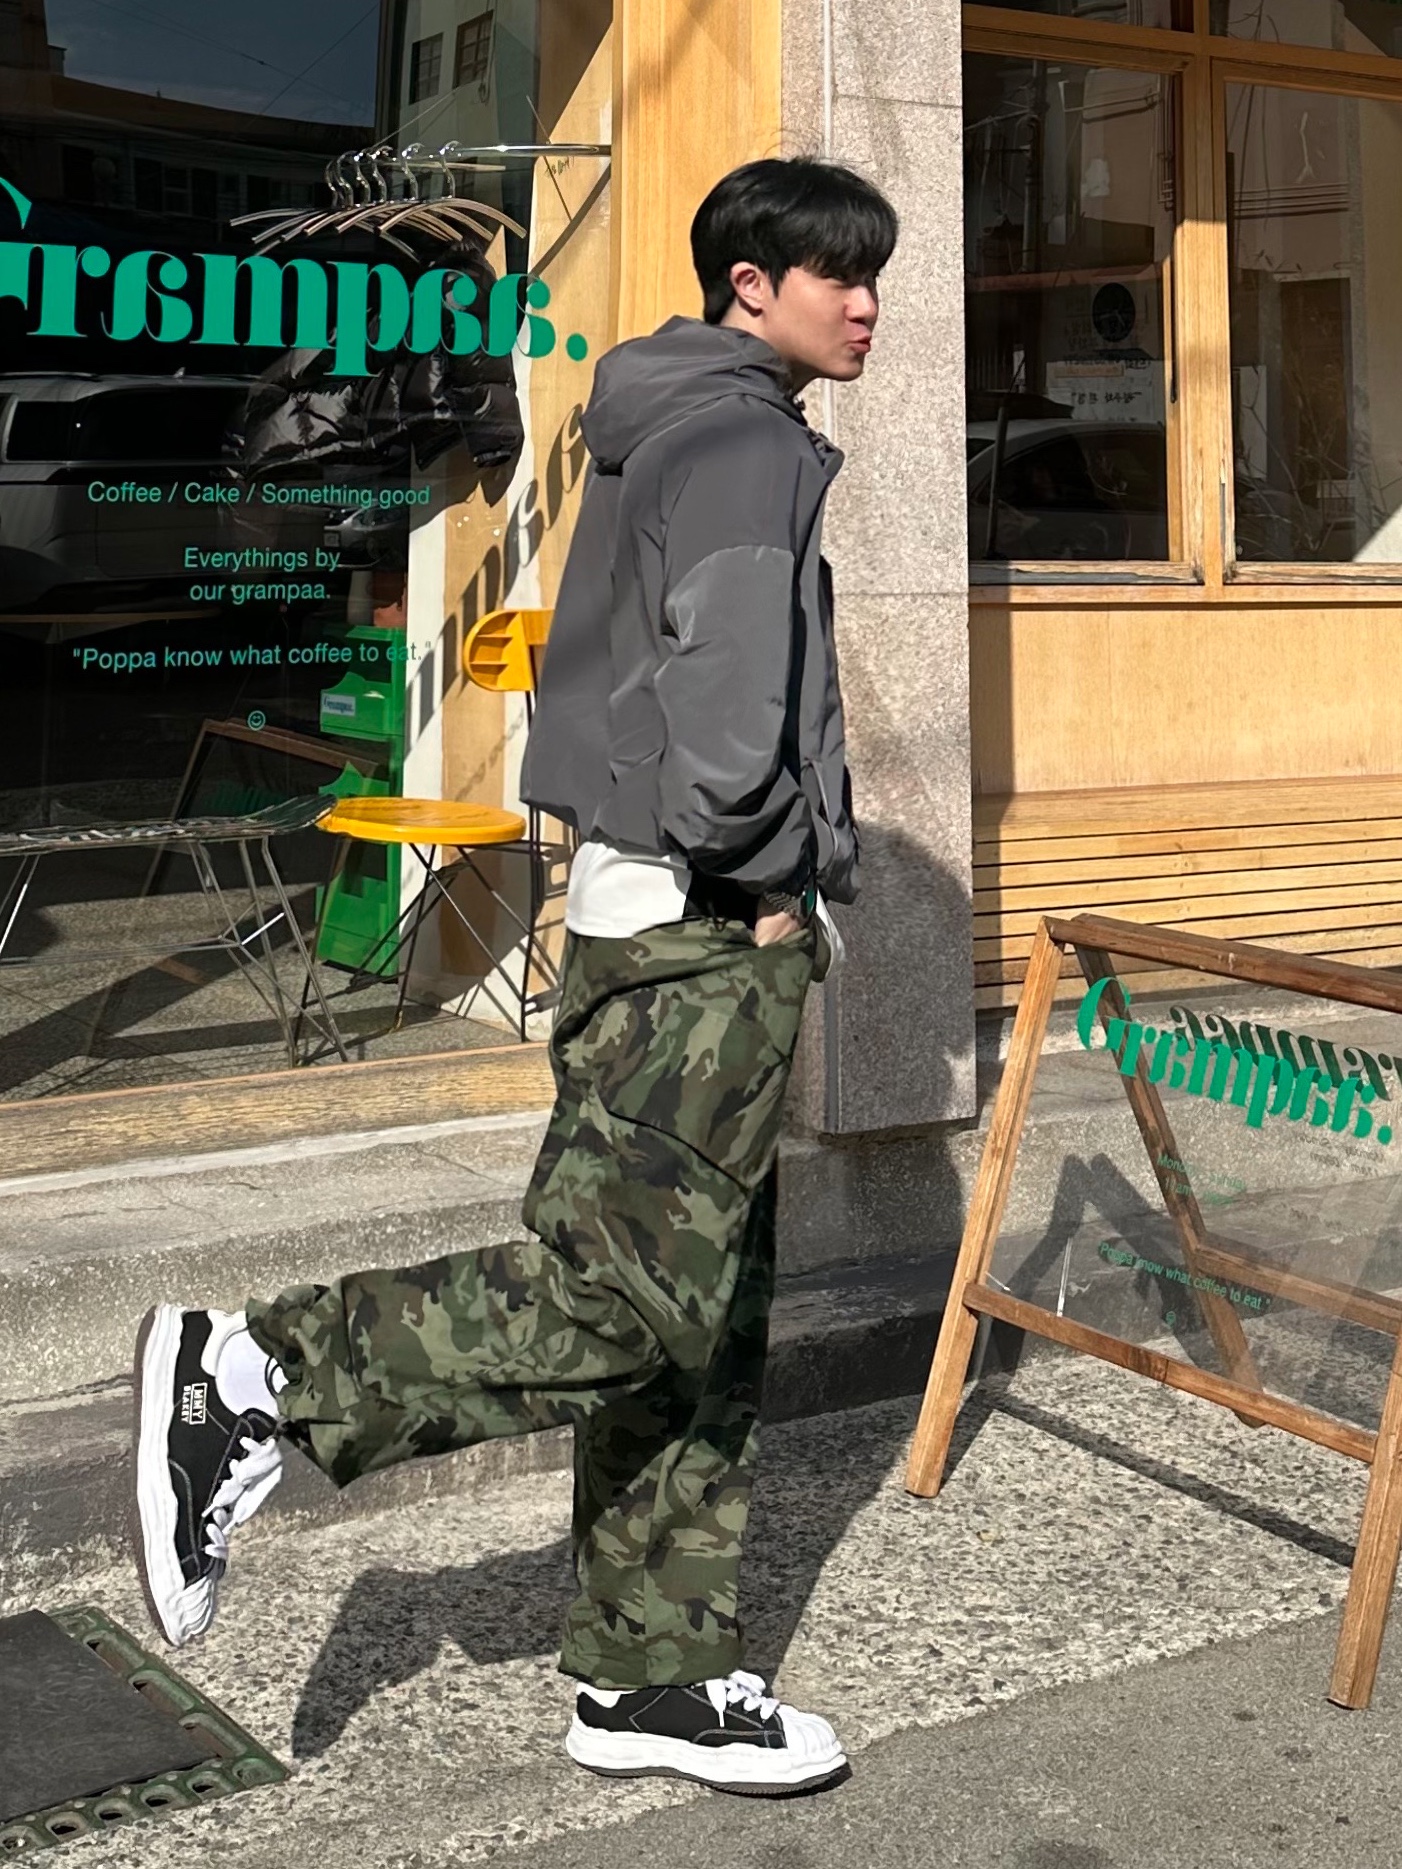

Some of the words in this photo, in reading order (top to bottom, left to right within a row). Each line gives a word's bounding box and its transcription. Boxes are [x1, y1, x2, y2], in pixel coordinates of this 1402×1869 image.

[0, 177, 588, 377] rampaa.
[87, 481, 162, 503] Coffee
[168, 482, 178, 502] /
[184, 483, 240, 503] Cake
[246, 483, 256, 503] /
[262, 483, 374, 508] Something
[379, 485, 431, 509] good
[184, 547, 308, 573] Everythings
[315, 548, 341, 572] by
[189, 585, 225, 601] our
[232, 583, 331, 605] grampaa.
[73, 648, 156, 674] "Poppa
[164, 647, 222, 667] know
[229, 645, 282, 665] what
[288, 643, 353, 664] coffee
[359, 643, 380, 662] to
